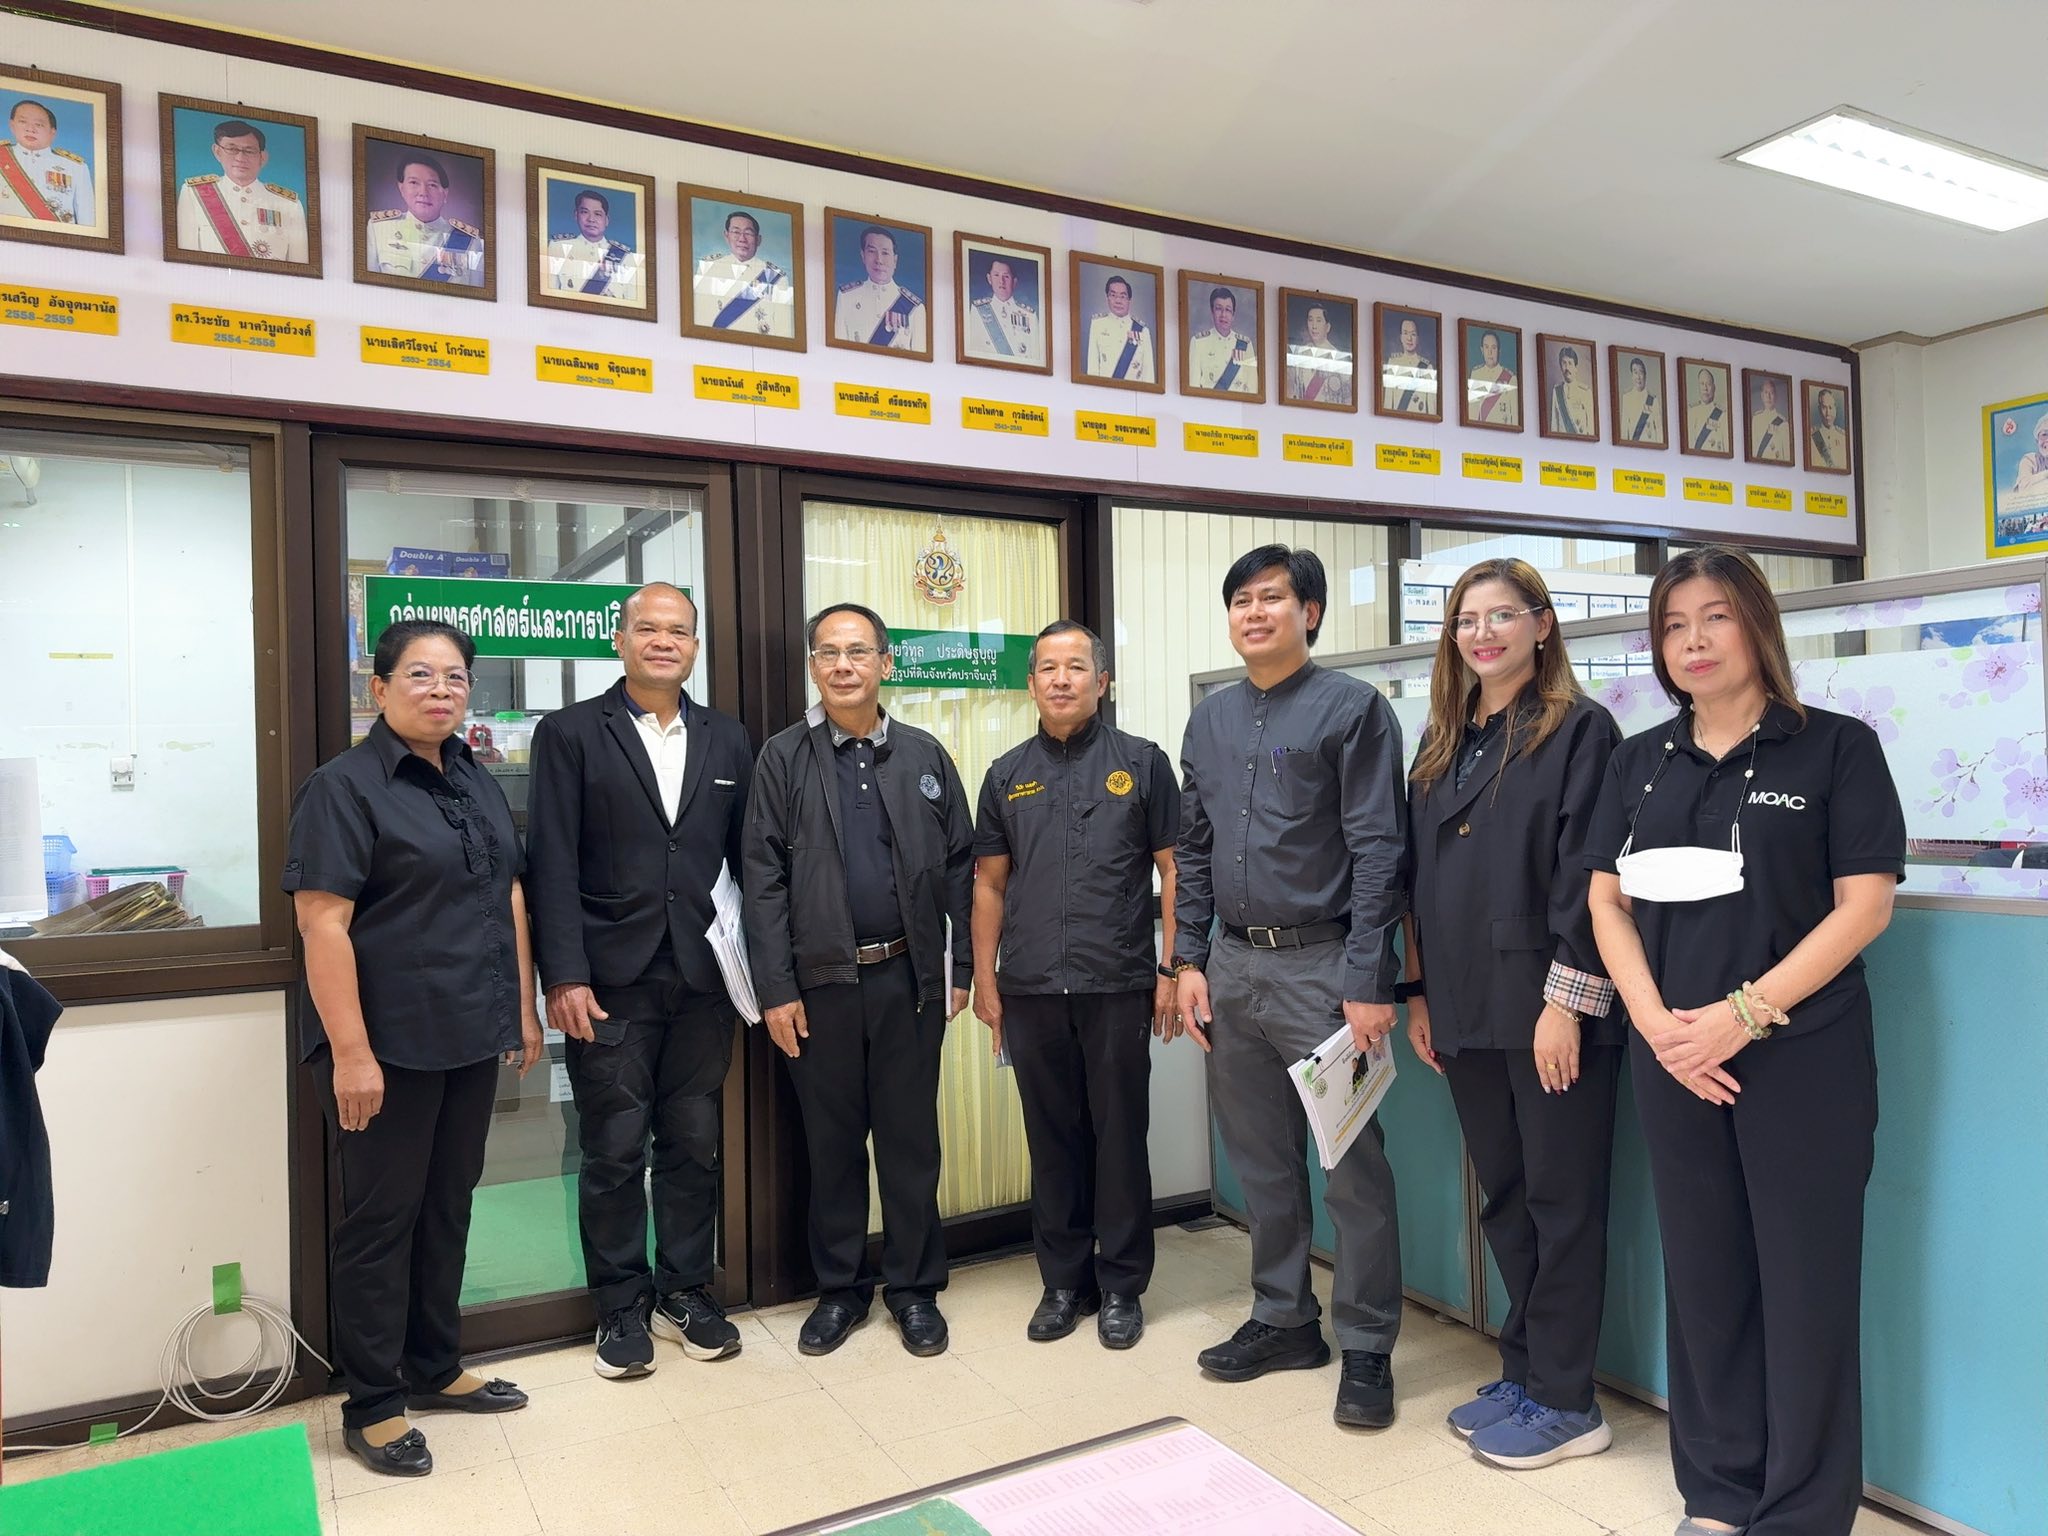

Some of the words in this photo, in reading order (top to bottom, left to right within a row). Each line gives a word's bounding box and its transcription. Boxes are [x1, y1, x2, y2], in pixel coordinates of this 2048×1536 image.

[0, 291, 39, 308] รเสริญ
[175, 311, 230, 328] ดร.วีระชัย
[543, 356, 599, 371] นายเฉลิมพร
[701, 376, 744, 389] นายอนันต์
[399, 550, 434, 561] Double
[436, 553, 445, 561] A
[937, 643, 997, 666] ประดิษฐบุญ
[1747, 791, 1806, 811] MOAC
